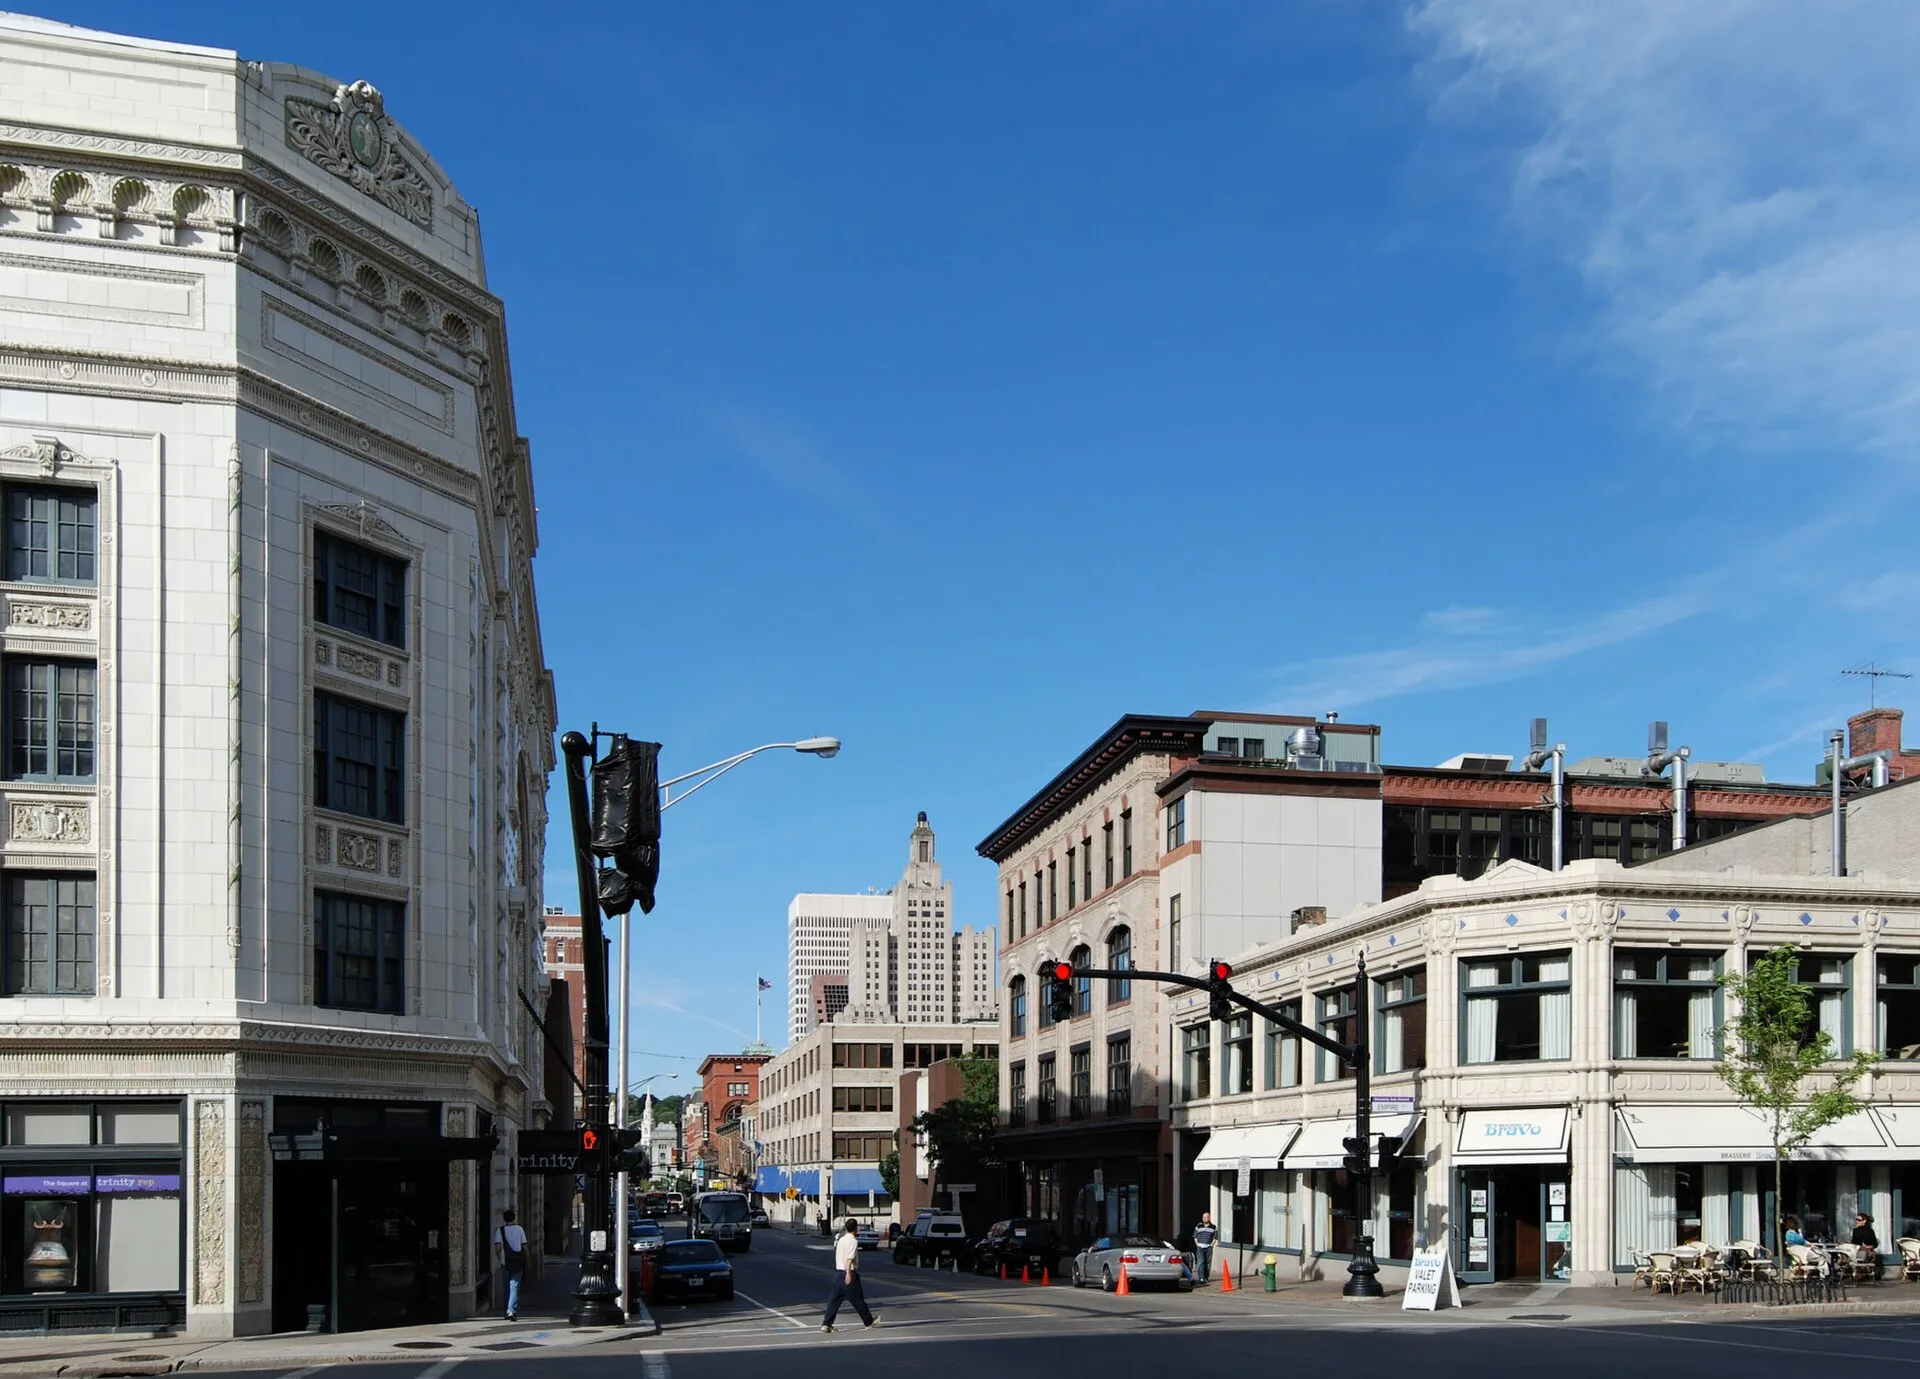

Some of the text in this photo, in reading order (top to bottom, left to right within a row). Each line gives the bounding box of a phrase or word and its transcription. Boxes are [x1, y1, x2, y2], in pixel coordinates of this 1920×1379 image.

[1377, 1103, 1400, 1111] EMPIRE
[1721, 1152, 1752, 1160] BRASSERIE
[519, 1154, 578, 1170] rinity
[56, 1180, 80, 1188] Square
[97, 1178, 135, 1187] trinity
[137, 1179, 156, 1188] rep
[1414, 1269, 1436, 1281] VALET
[1407, 1282, 1437, 1295] PARKING
